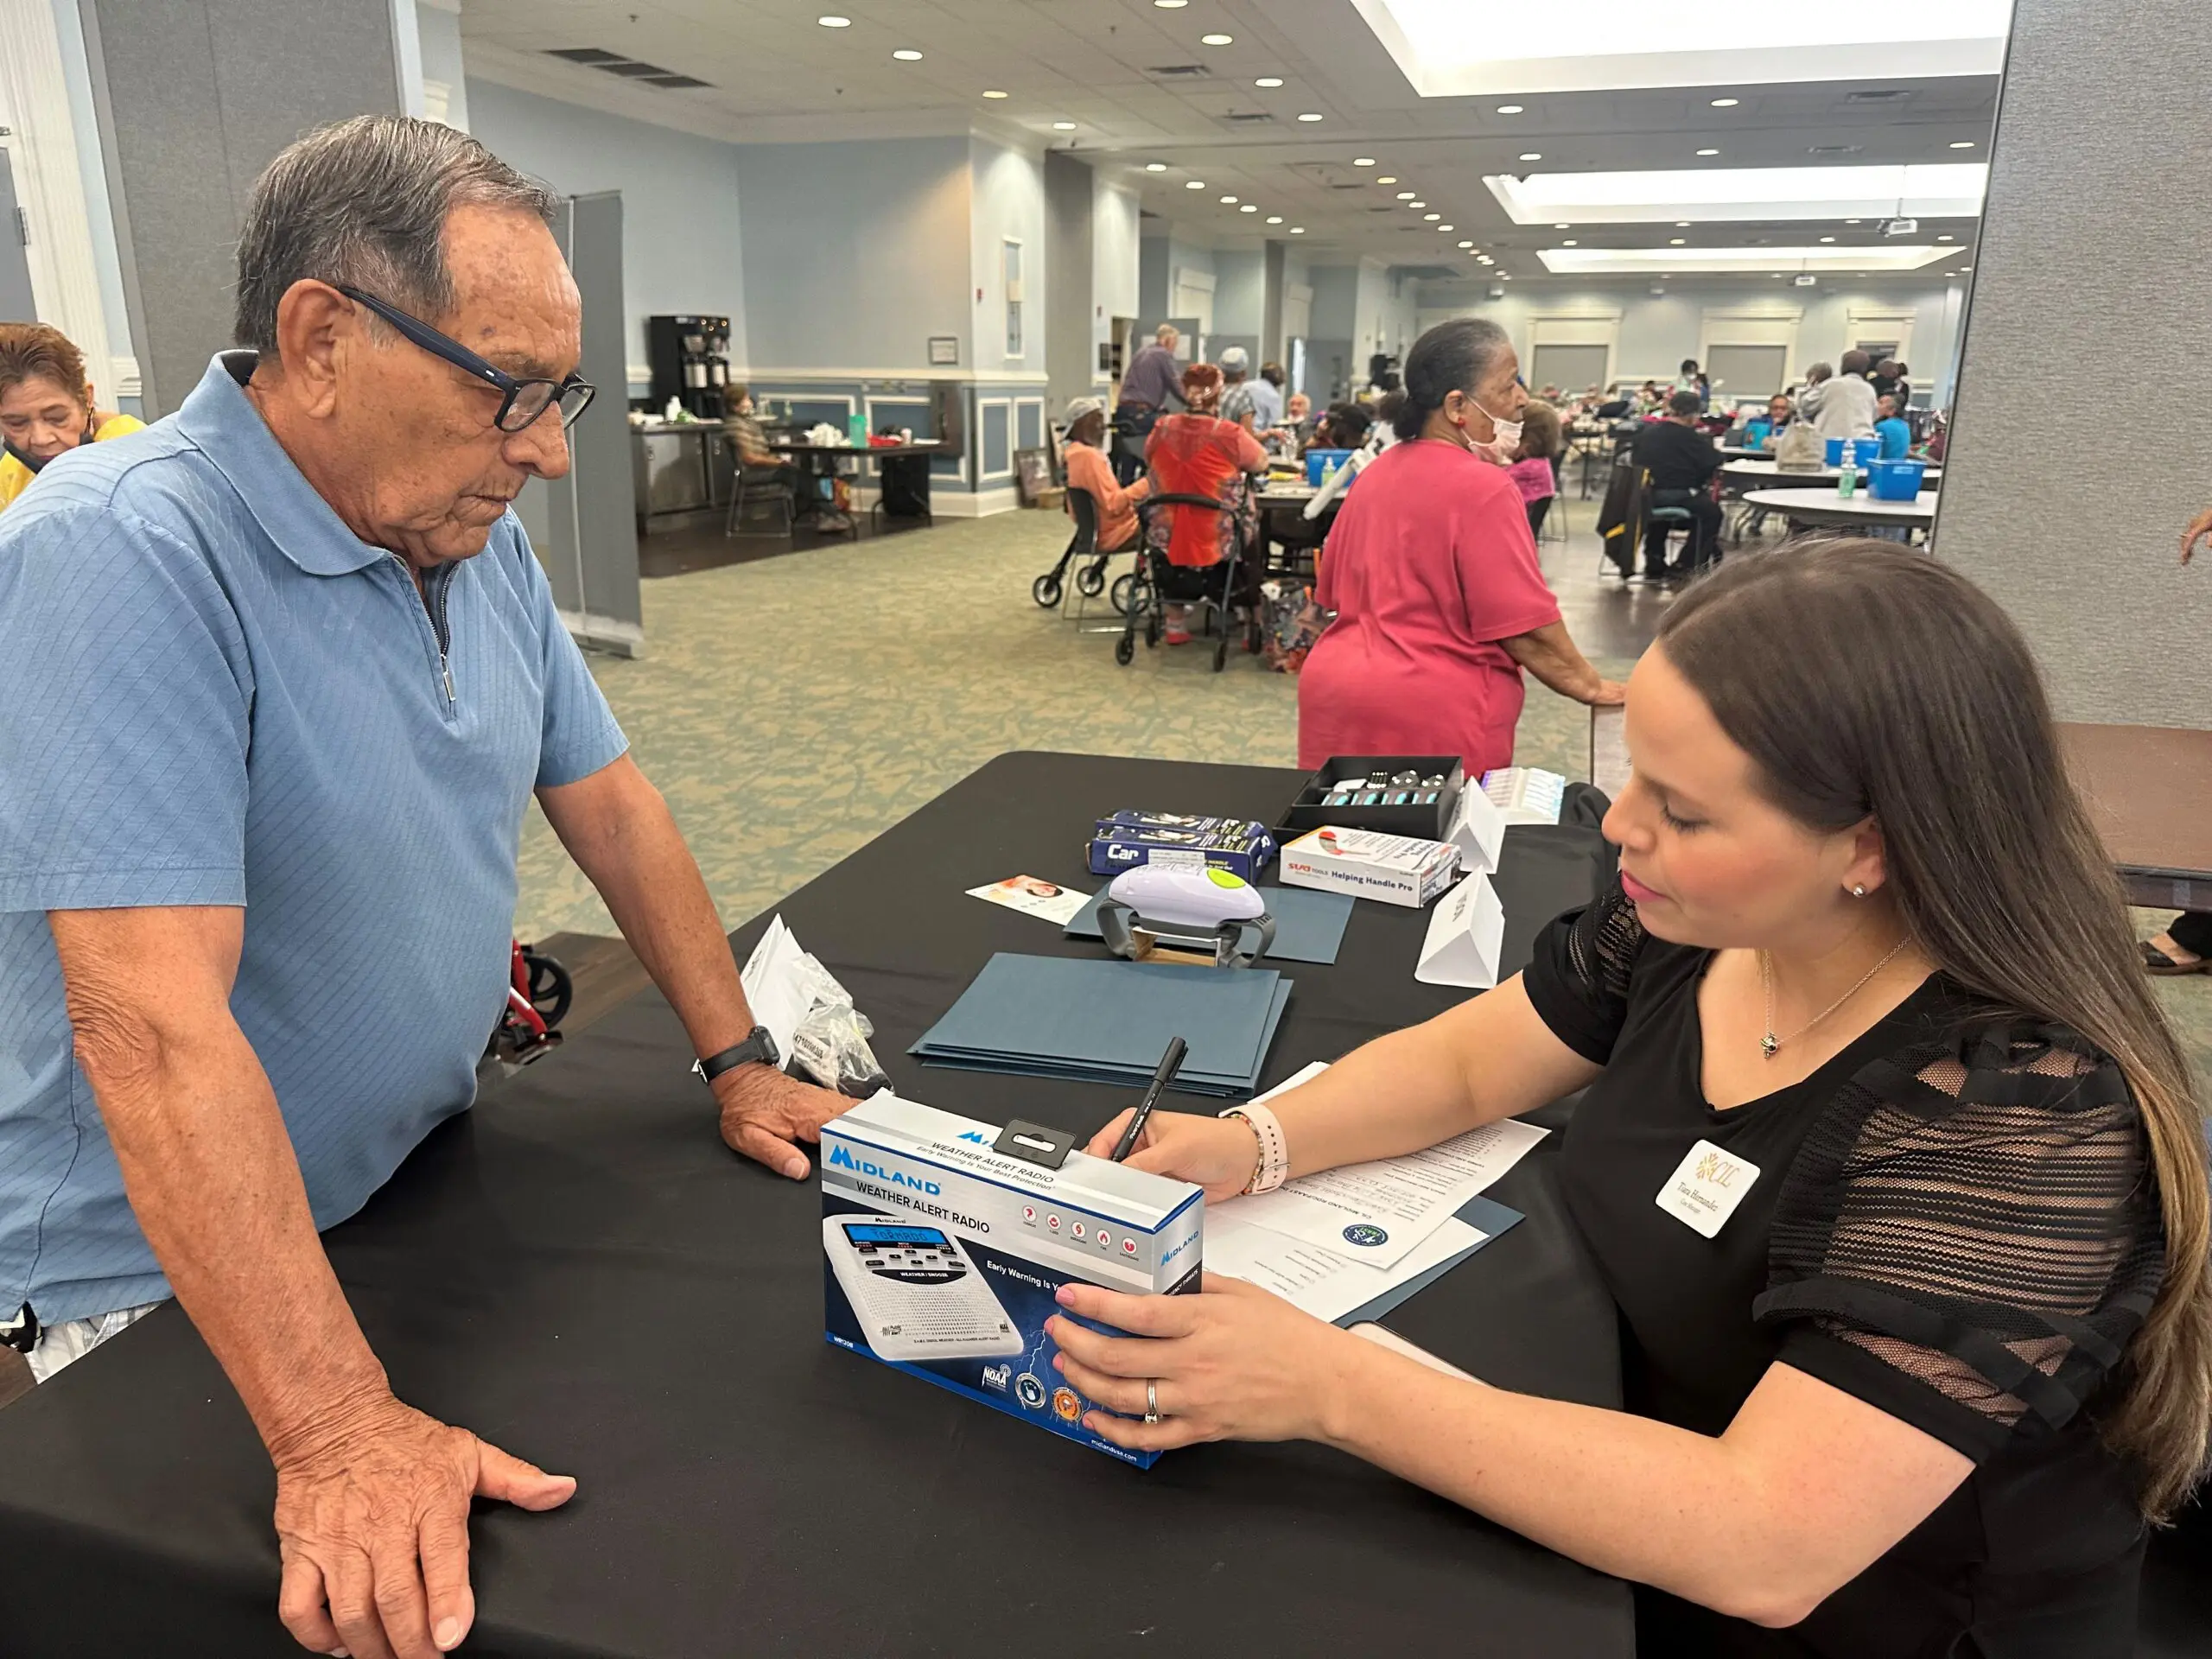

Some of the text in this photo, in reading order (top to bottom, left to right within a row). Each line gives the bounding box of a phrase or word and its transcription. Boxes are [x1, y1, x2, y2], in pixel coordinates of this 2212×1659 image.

[1107, 843, 1139, 861] Car
[1332, 870, 1363, 885] Helping
[1366, 876, 1396, 889] Handle
[1398, 882, 1414, 892] Pro
[830, 1144, 941, 1197] MIDLAND
[916, 1146, 936, 1156] Early
[937, 1150, 966, 1166] Warning
[976, 1163, 993, 1173] Your
[993, 1167, 1011, 1178] Best
[931, 1142, 1054, 1183] WEATHER ALERT RADIO
[856, 1180, 990, 1234] WEATHER ALERT RADIO
[1160, 1230, 1199, 1267] MIDLAND
[987, 1260, 1007, 1275] Early
[1007, 1267, 1042, 1287] Warning
[1043, 1280, 1051, 1289] Is
[983, 1367, 1007, 1385] NOAA
[1091, 1439, 1137, 1462] midlandusa.com
